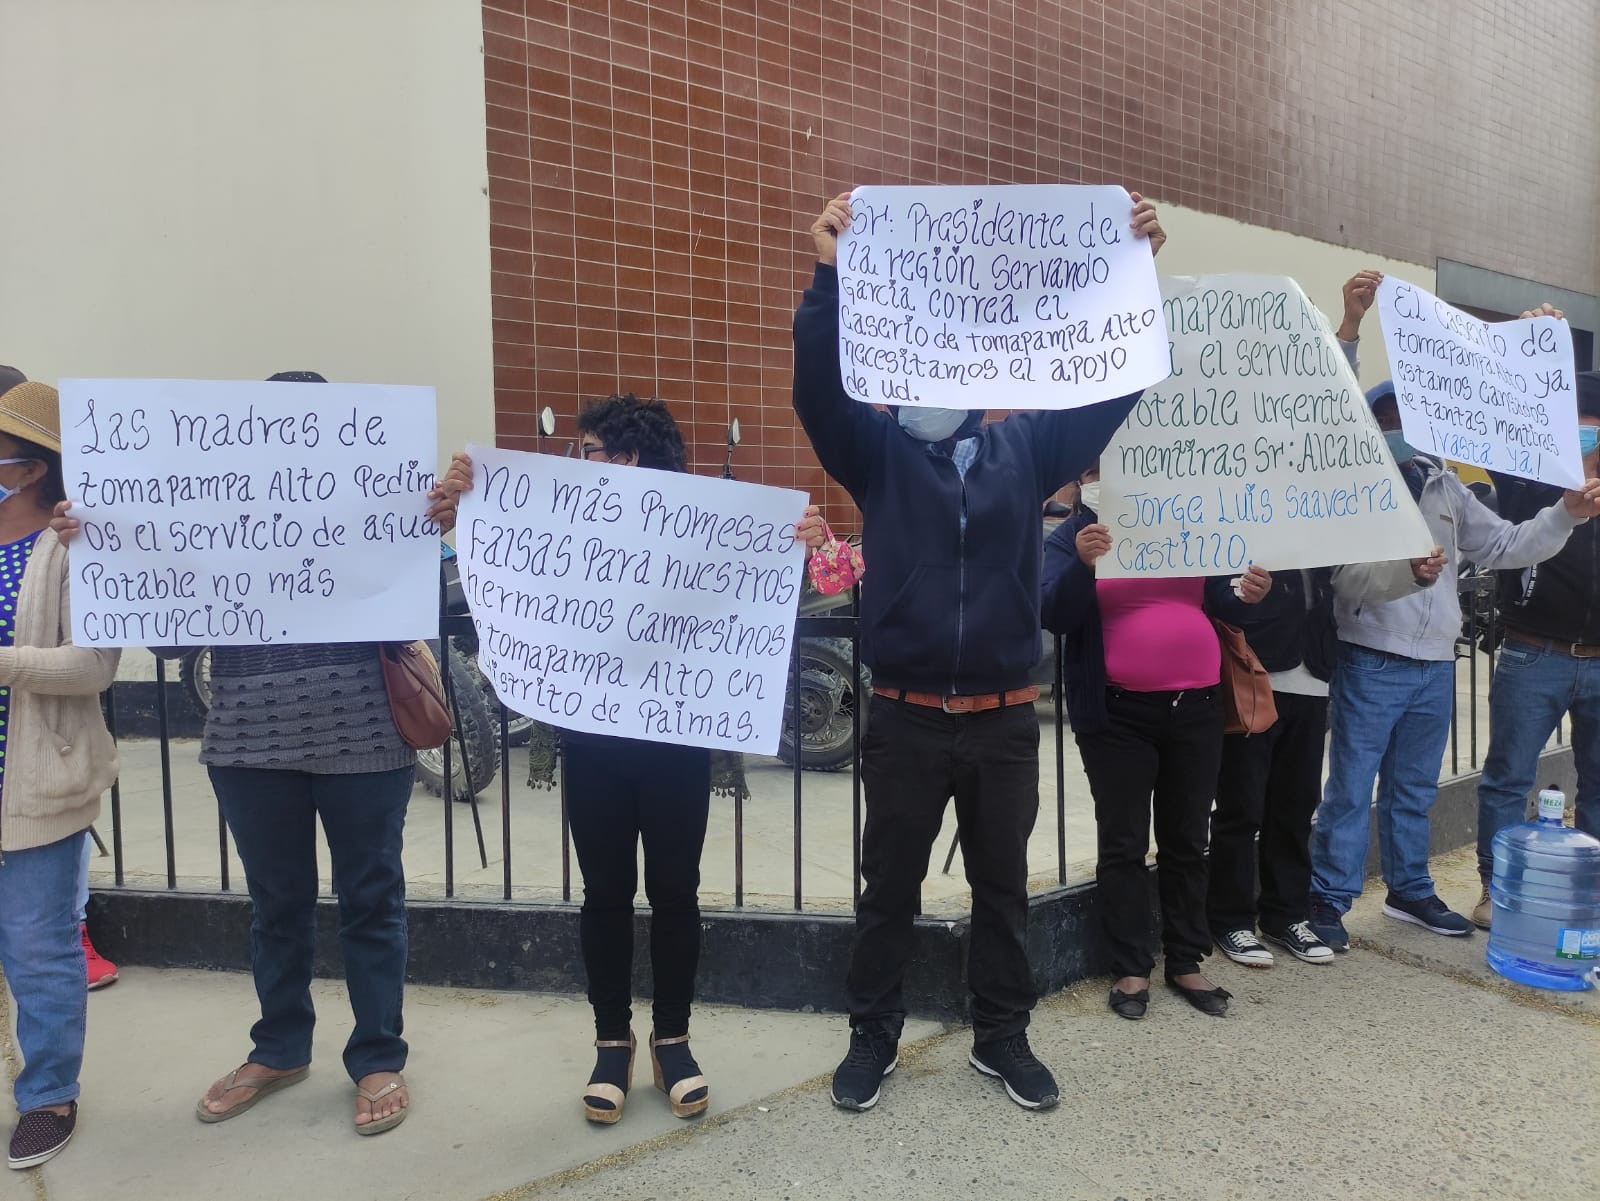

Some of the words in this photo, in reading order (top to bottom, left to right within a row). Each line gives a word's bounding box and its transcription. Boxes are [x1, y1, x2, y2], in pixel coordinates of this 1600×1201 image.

[850, 199, 893, 237] Sr:
[908, 199, 1069, 249] Presidente
[1078, 202, 1121, 249] de
[848, 241, 879, 276] la
[1035, 295, 1069, 321] el
[1163, 289, 1292, 335] mapampa
[934, 323, 959, 352] de
[1100, 308, 1157, 343] Alto
[1521, 324, 1557, 357] de
[841, 336, 998, 386] necesitamos
[1009, 356, 1036, 382] el
[1051, 346, 1127, 386] apoyo
[1200, 339, 1228, 378] el
[846, 374, 869, 399] de
[1398, 359, 1473, 401] estamos
[1535, 370, 1571, 399] ya
[74, 398, 150, 454] Las
[171, 405, 321, 452] madres
[338, 407, 387, 447] de
[1254, 388, 1358, 429] urgente
[1401, 386, 1417, 411] de
[1421, 395, 1488, 436] tantas
[1118, 438, 1248, 481] mentiras
[1505, 446, 1542, 480] ya!
[268, 467, 336, 502] Alto
[1118, 493, 1205, 529] Jorge
[1218, 482, 1274, 525] Luis
[1286, 478, 1399, 520] Saavedra
[84, 520, 122, 552] os
[135, 520, 162, 552] el
[170, 514, 303, 552] servicio
[313, 516, 346, 547] de
[364, 513, 440, 543] agua
[641, 490, 796, 554] Promesas
[470, 518, 571, 577] Falsas
[662, 553, 795, 605] nuestros
[213, 571, 251, 602] no
[467, 565, 614, 634] hermanos
[640, 660, 714, 700] Alto
[727, 667, 766, 700] en
[591, 694, 620, 724] de
